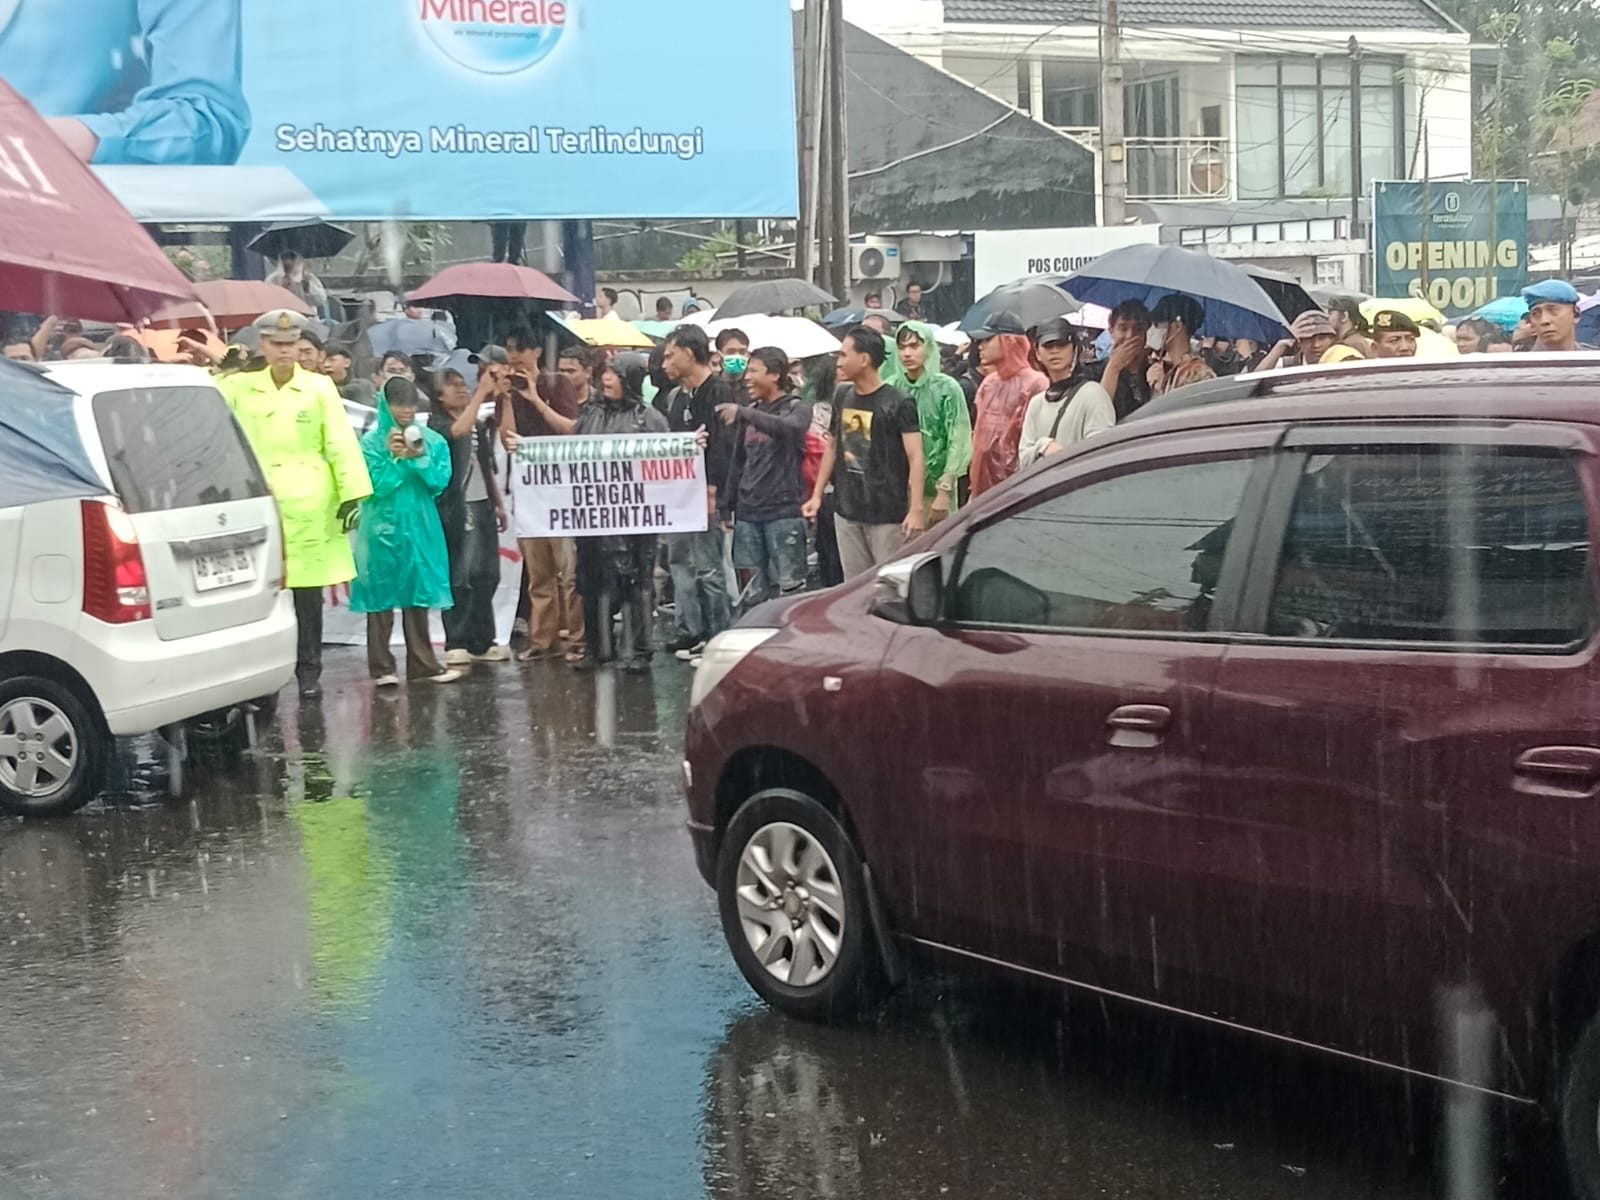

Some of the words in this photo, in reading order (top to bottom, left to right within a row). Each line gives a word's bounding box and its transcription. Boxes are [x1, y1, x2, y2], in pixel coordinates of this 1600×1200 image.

[420, 0, 566, 25] Minerale
[276, 123, 422, 158] Sehatnya
[429, 124, 539, 153] Mineral
[545, 125, 704, 159] Terlindungi
[1028, 258, 1051, 273] POS
[1385, 239, 1518, 271] OPENING
[1408, 276, 1498, 309] SOON
[515, 440, 603, 464] BUNYIKAN
[522, 461, 563, 485] JIKA
[569, 460, 634, 484] KALIAN
[641, 458, 697, 482] MUAK
[572, 483, 645, 507] DENGAN
[549, 504, 673, 531] PEMERINTAH.
